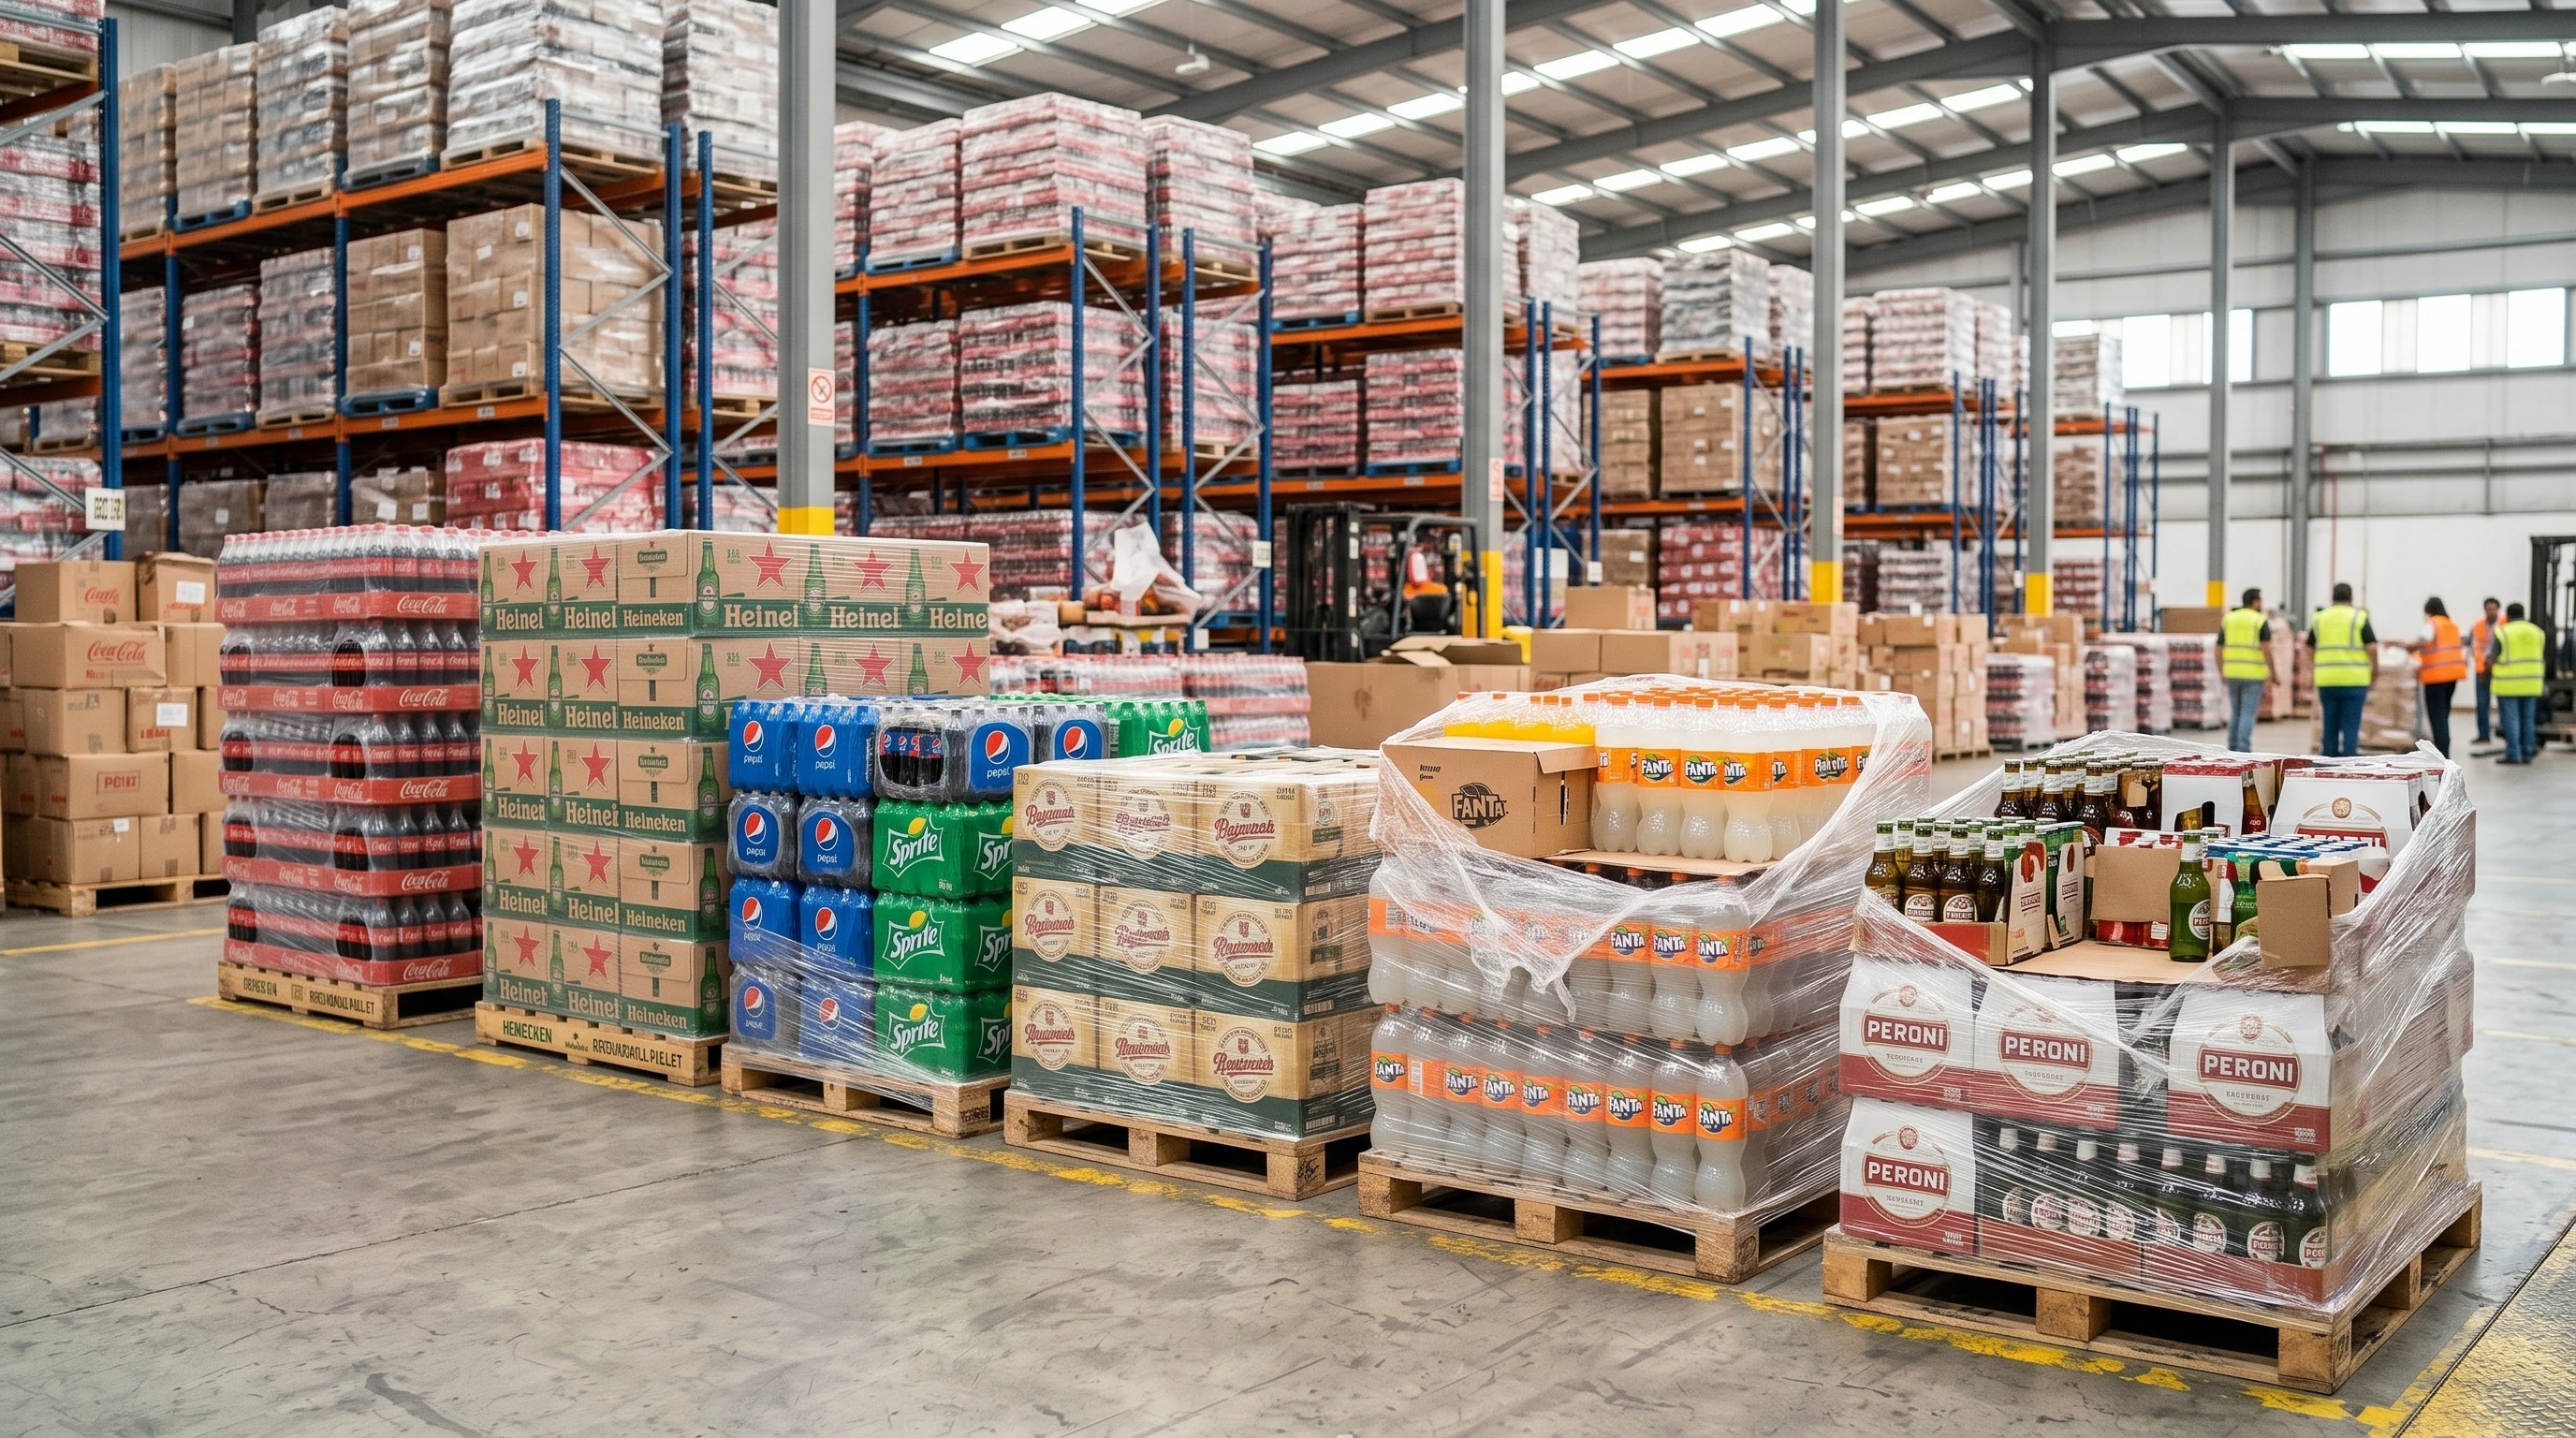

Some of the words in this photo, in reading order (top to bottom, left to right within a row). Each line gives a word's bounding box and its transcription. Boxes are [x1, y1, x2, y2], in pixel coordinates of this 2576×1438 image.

[623, 609, 683, 626] Heineken
[622, 711, 685, 730] Heineken
[1454, 794, 1505, 818] FANTA
[890, 831, 938, 867] Sprite
[626, 910, 685, 932] Heineken
[890, 925, 938, 961] Sprite
[1611, 932, 1646, 947] FANTA
[1653, 934, 1687, 951] FANTA
[891, 1019, 940, 1056] Sprite
[1868, 1020, 1944, 1047] PERONI
[2005, 1035, 2086, 1062] PERONI
[2204, 1054, 2293, 1082] PERONI
[1567, 1092, 1601, 1107] FANTA
[1608, 1095, 1643, 1112] FANTA
[1653, 1101, 1687, 1118] FANTA
[1699, 1108, 1733, 1124] FANTA
[1868, 1161, 1945, 1191] PERONI
